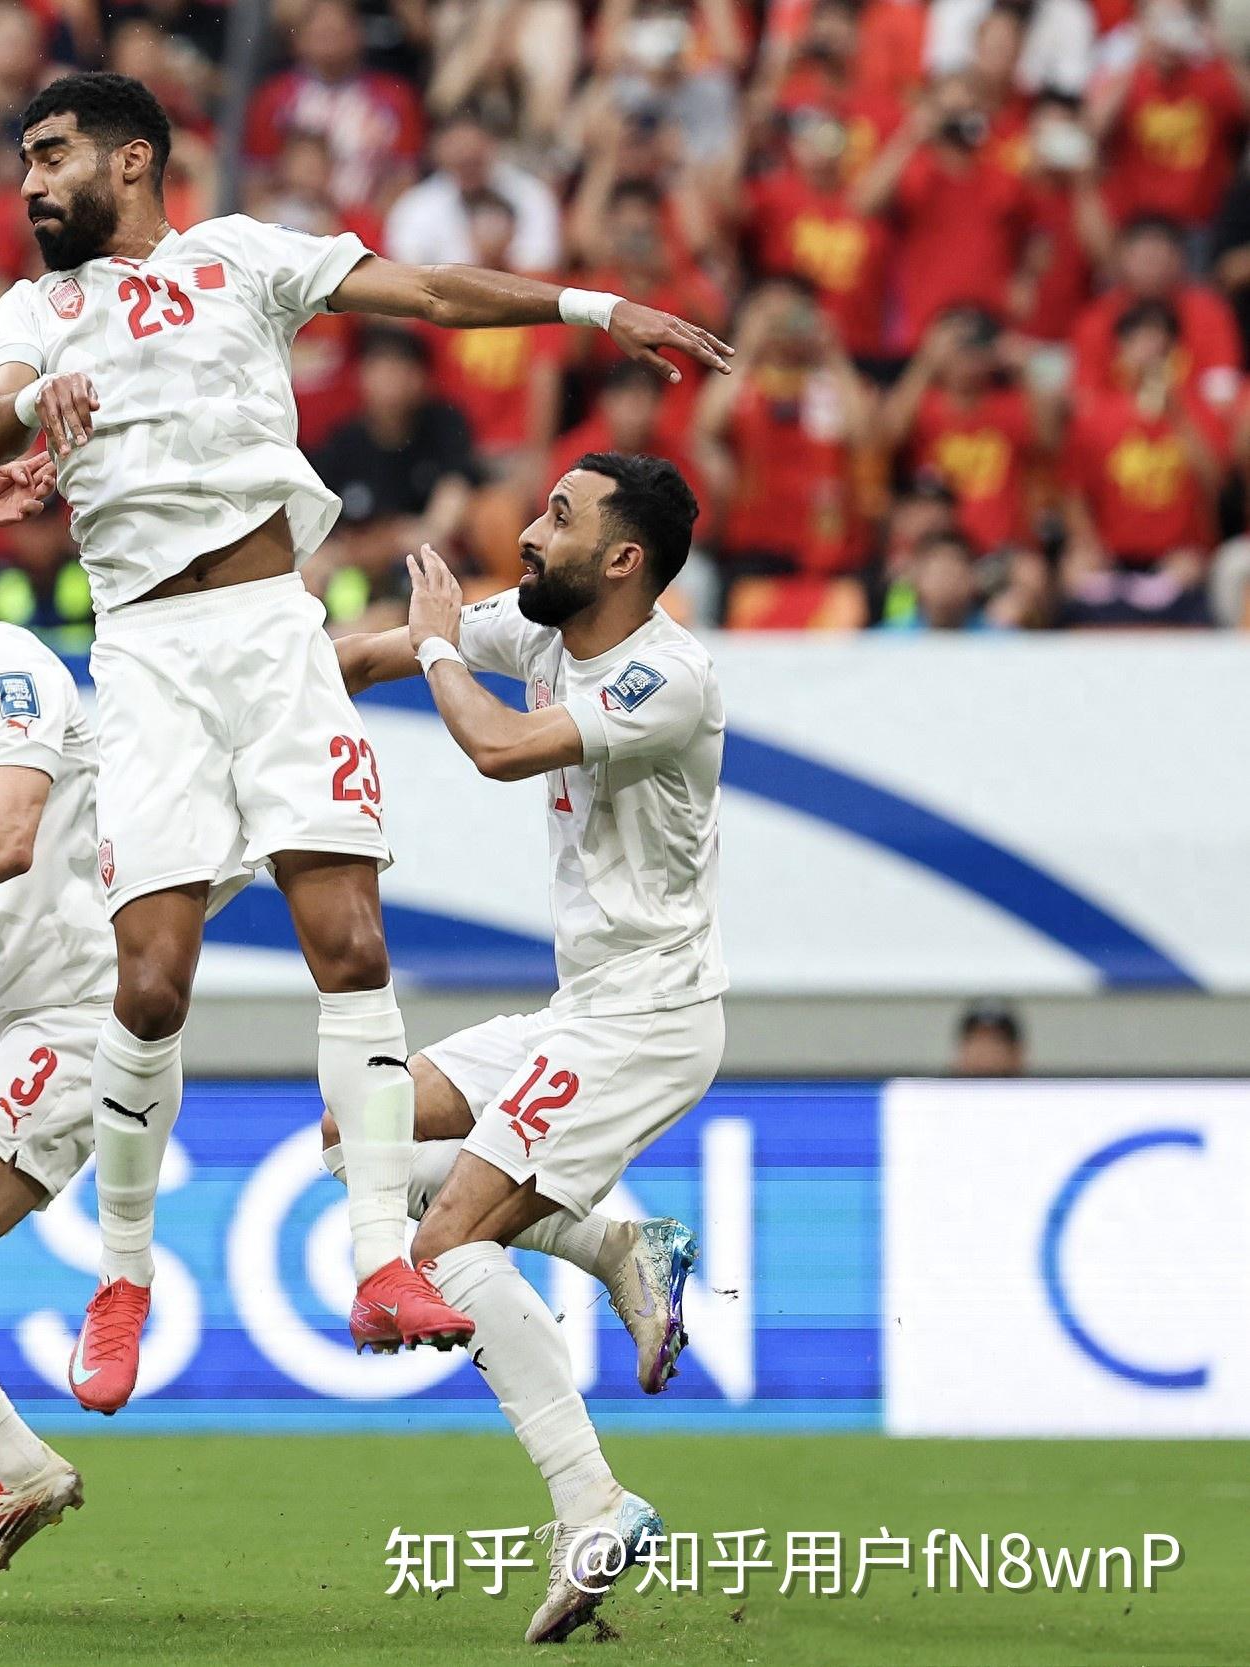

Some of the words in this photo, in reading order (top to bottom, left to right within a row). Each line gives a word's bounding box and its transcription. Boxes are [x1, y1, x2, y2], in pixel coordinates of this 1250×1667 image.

[117, 274, 195, 340] 23
[329, 734, 382, 805] 23
[10, 1046, 58, 1107] 3
[499, 1055, 580, 1135] 12
